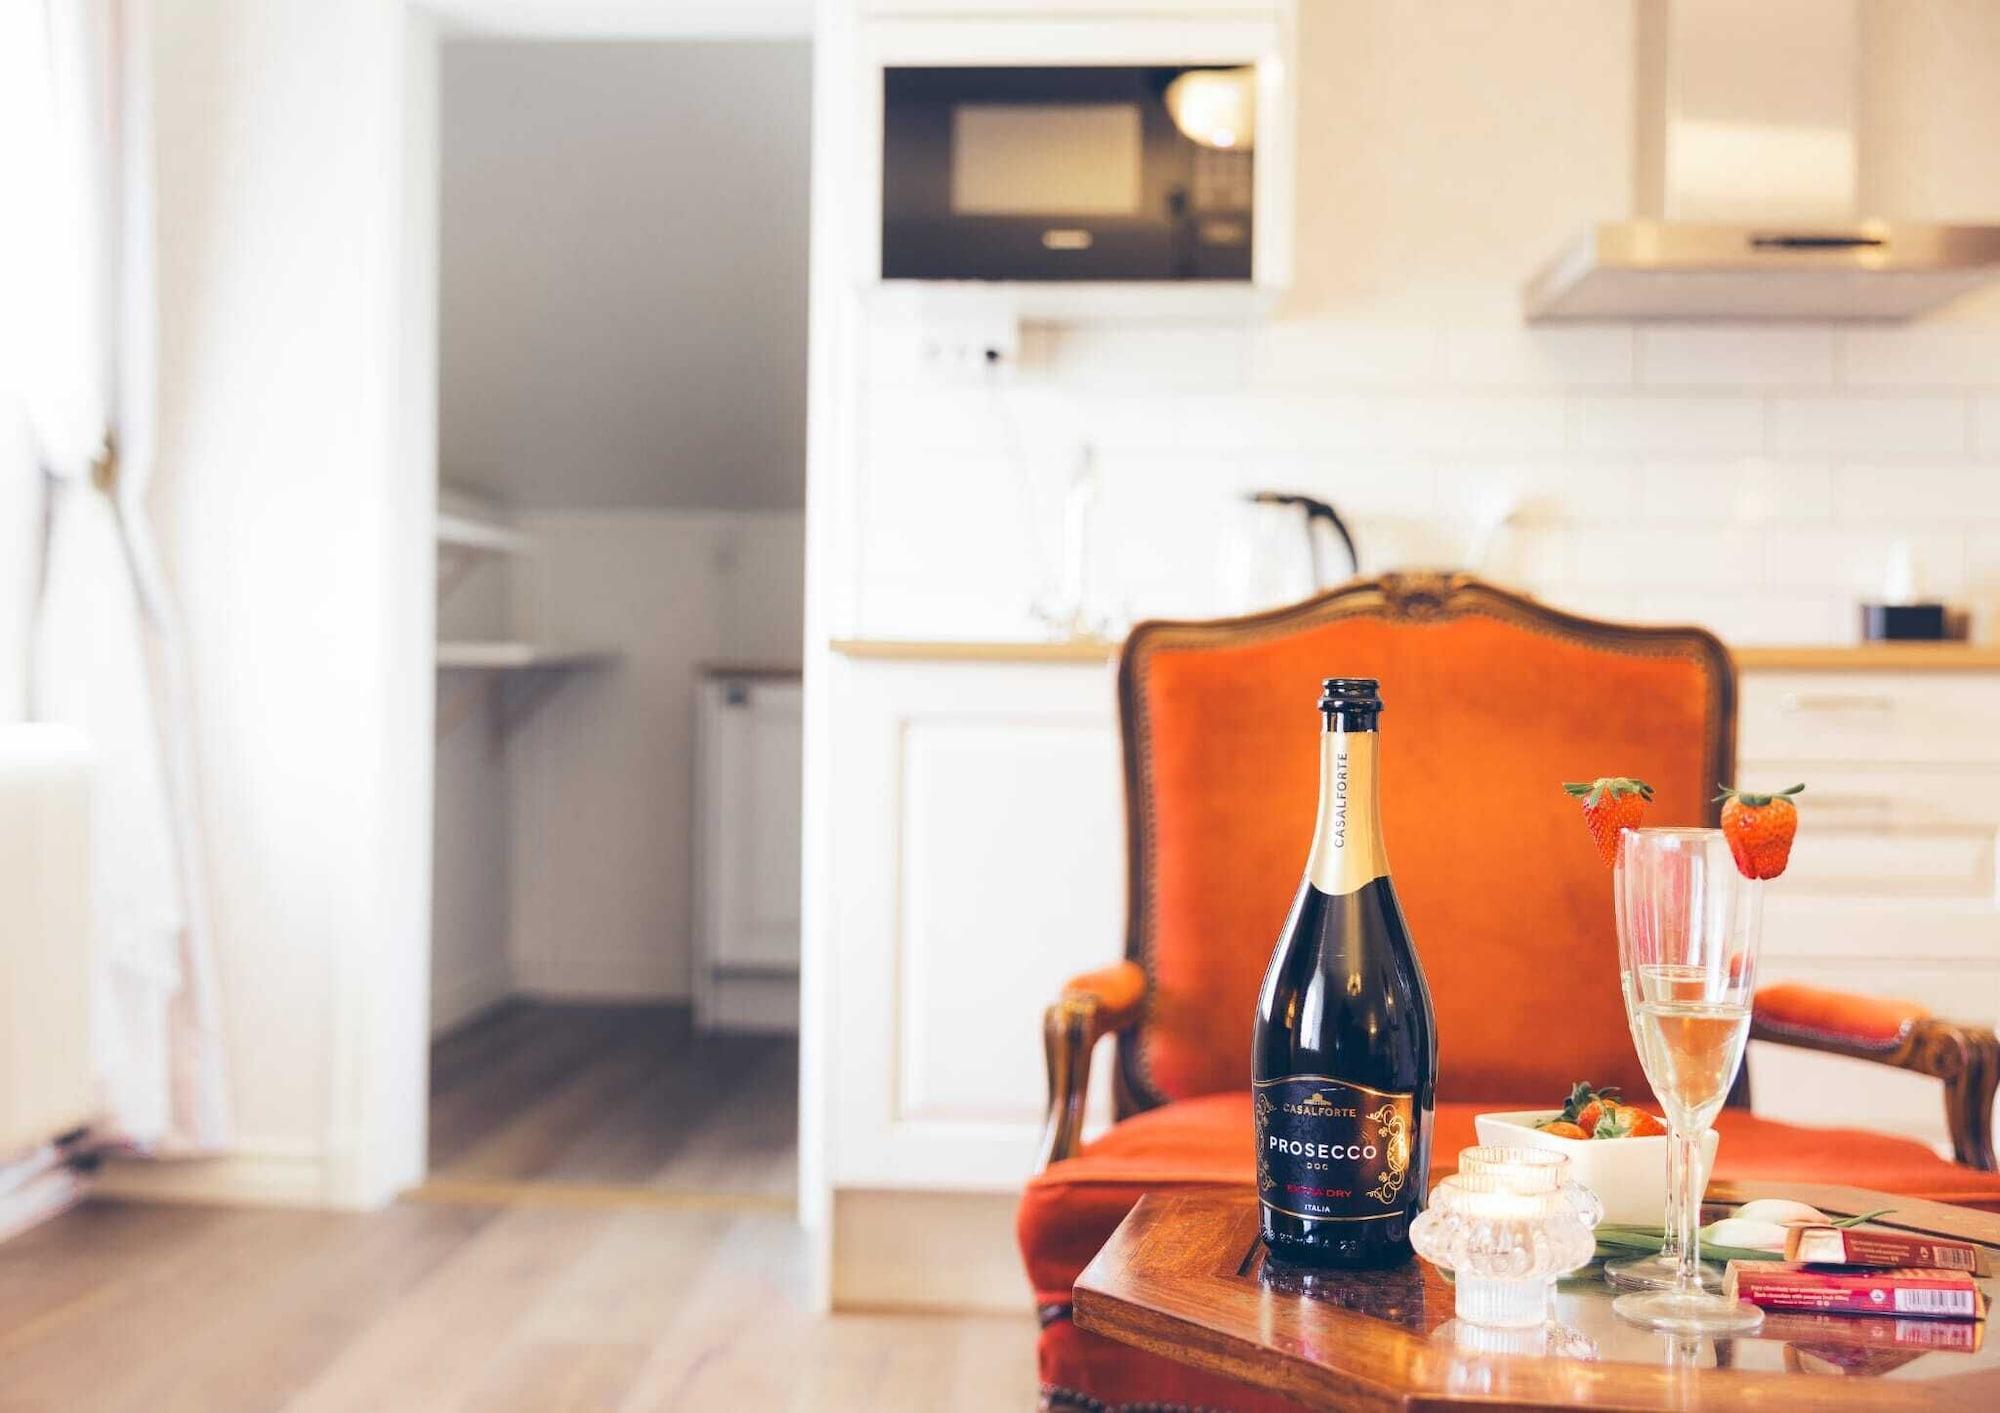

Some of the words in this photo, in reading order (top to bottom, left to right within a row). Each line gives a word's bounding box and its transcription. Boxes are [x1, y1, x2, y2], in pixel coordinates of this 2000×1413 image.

[1335, 752, 1348, 848] CASALFORTE
[1283, 1103, 1357, 1117] CASALFORTE
[1269, 1135, 1377, 1160] PROSECCO
[1306, 1162, 1329, 1171] DOC
[1325, 1188, 1352, 1198] DRY
[1304, 1203, 1331, 1213] ITALIA
